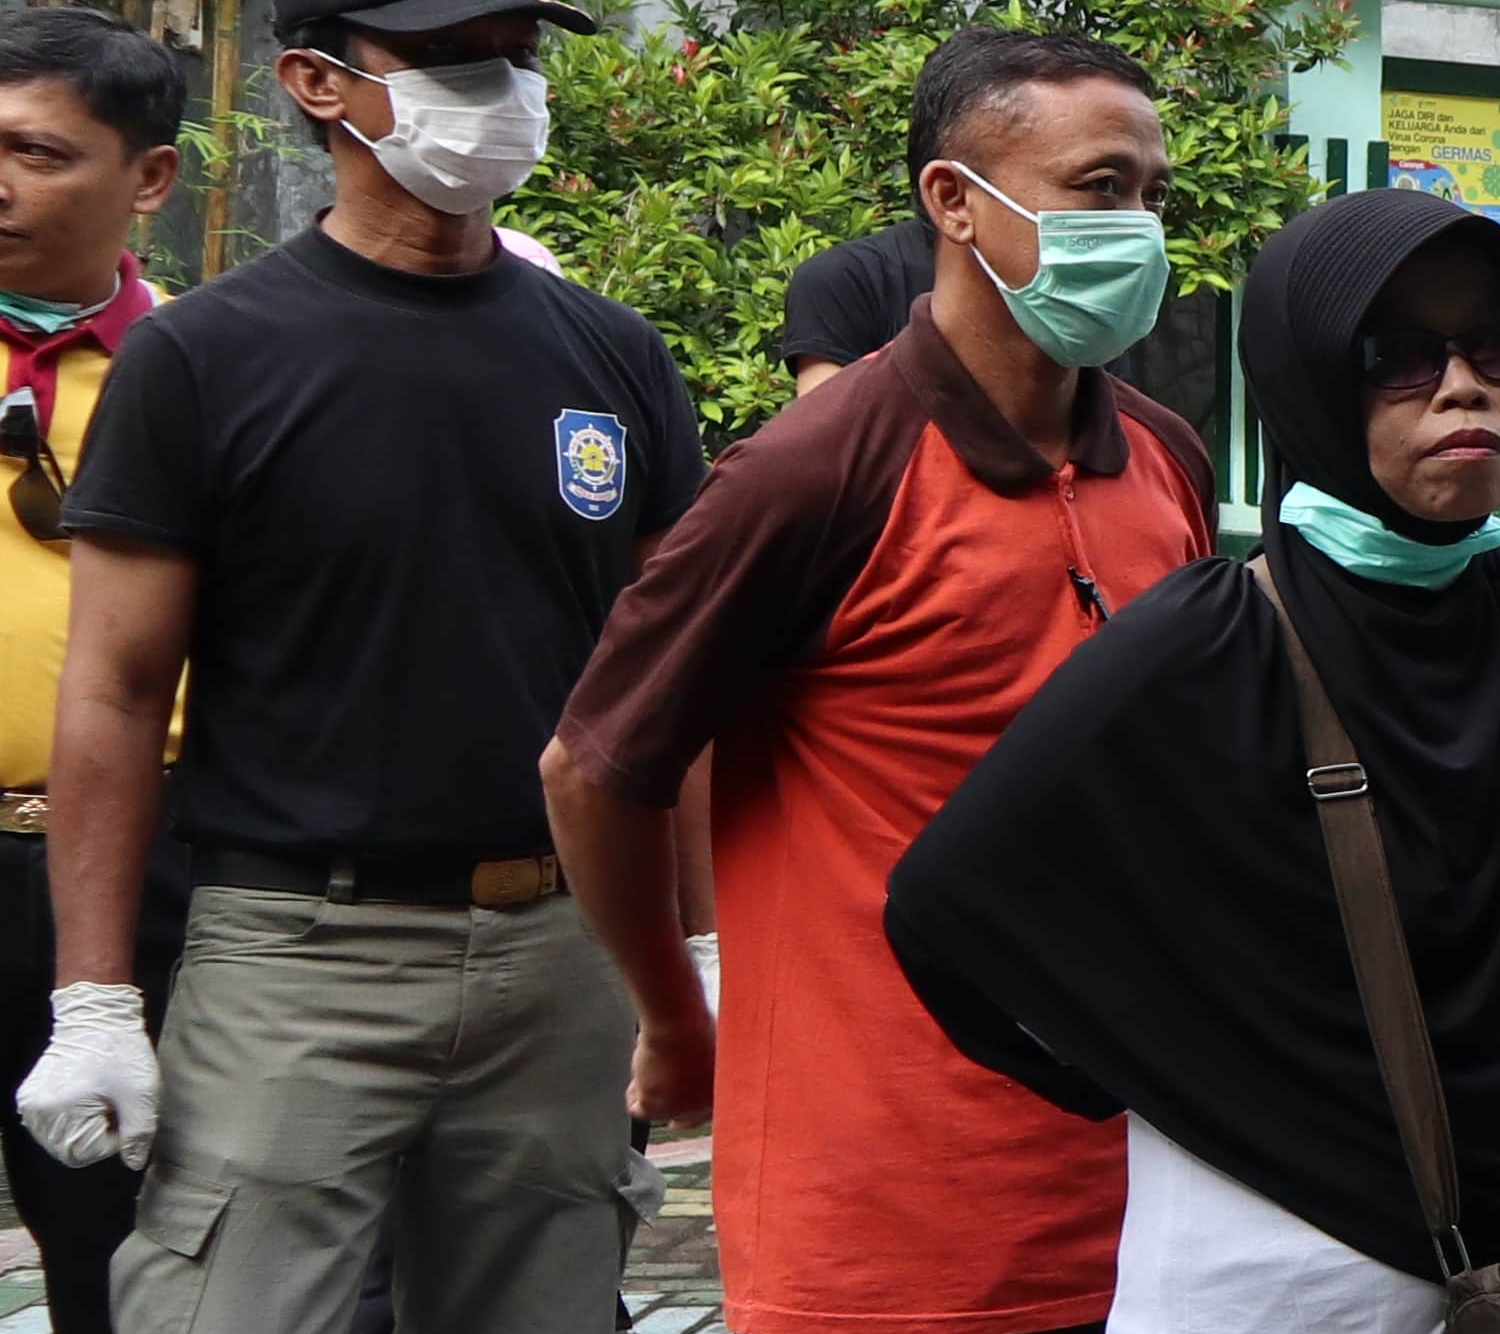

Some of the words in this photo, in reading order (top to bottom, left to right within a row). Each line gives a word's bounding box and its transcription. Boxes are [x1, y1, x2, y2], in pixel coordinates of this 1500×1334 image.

[1388, 109, 1415, 119] JAGA
[1417, 110, 1436, 121] DIRI
[1437, 112, 1454, 122] dan
[1388, 121, 1442, 133] KELUARGA
[1444, 124, 1468, 135] Anda
[1470, 125, 1486, 135] dari
[1388, 132, 1411, 143] Virus
[1413, 133, 1446, 145] Corona
[1388, 145, 1422, 156] dengan
[1430, 146, 1492, 162] GERMAS
